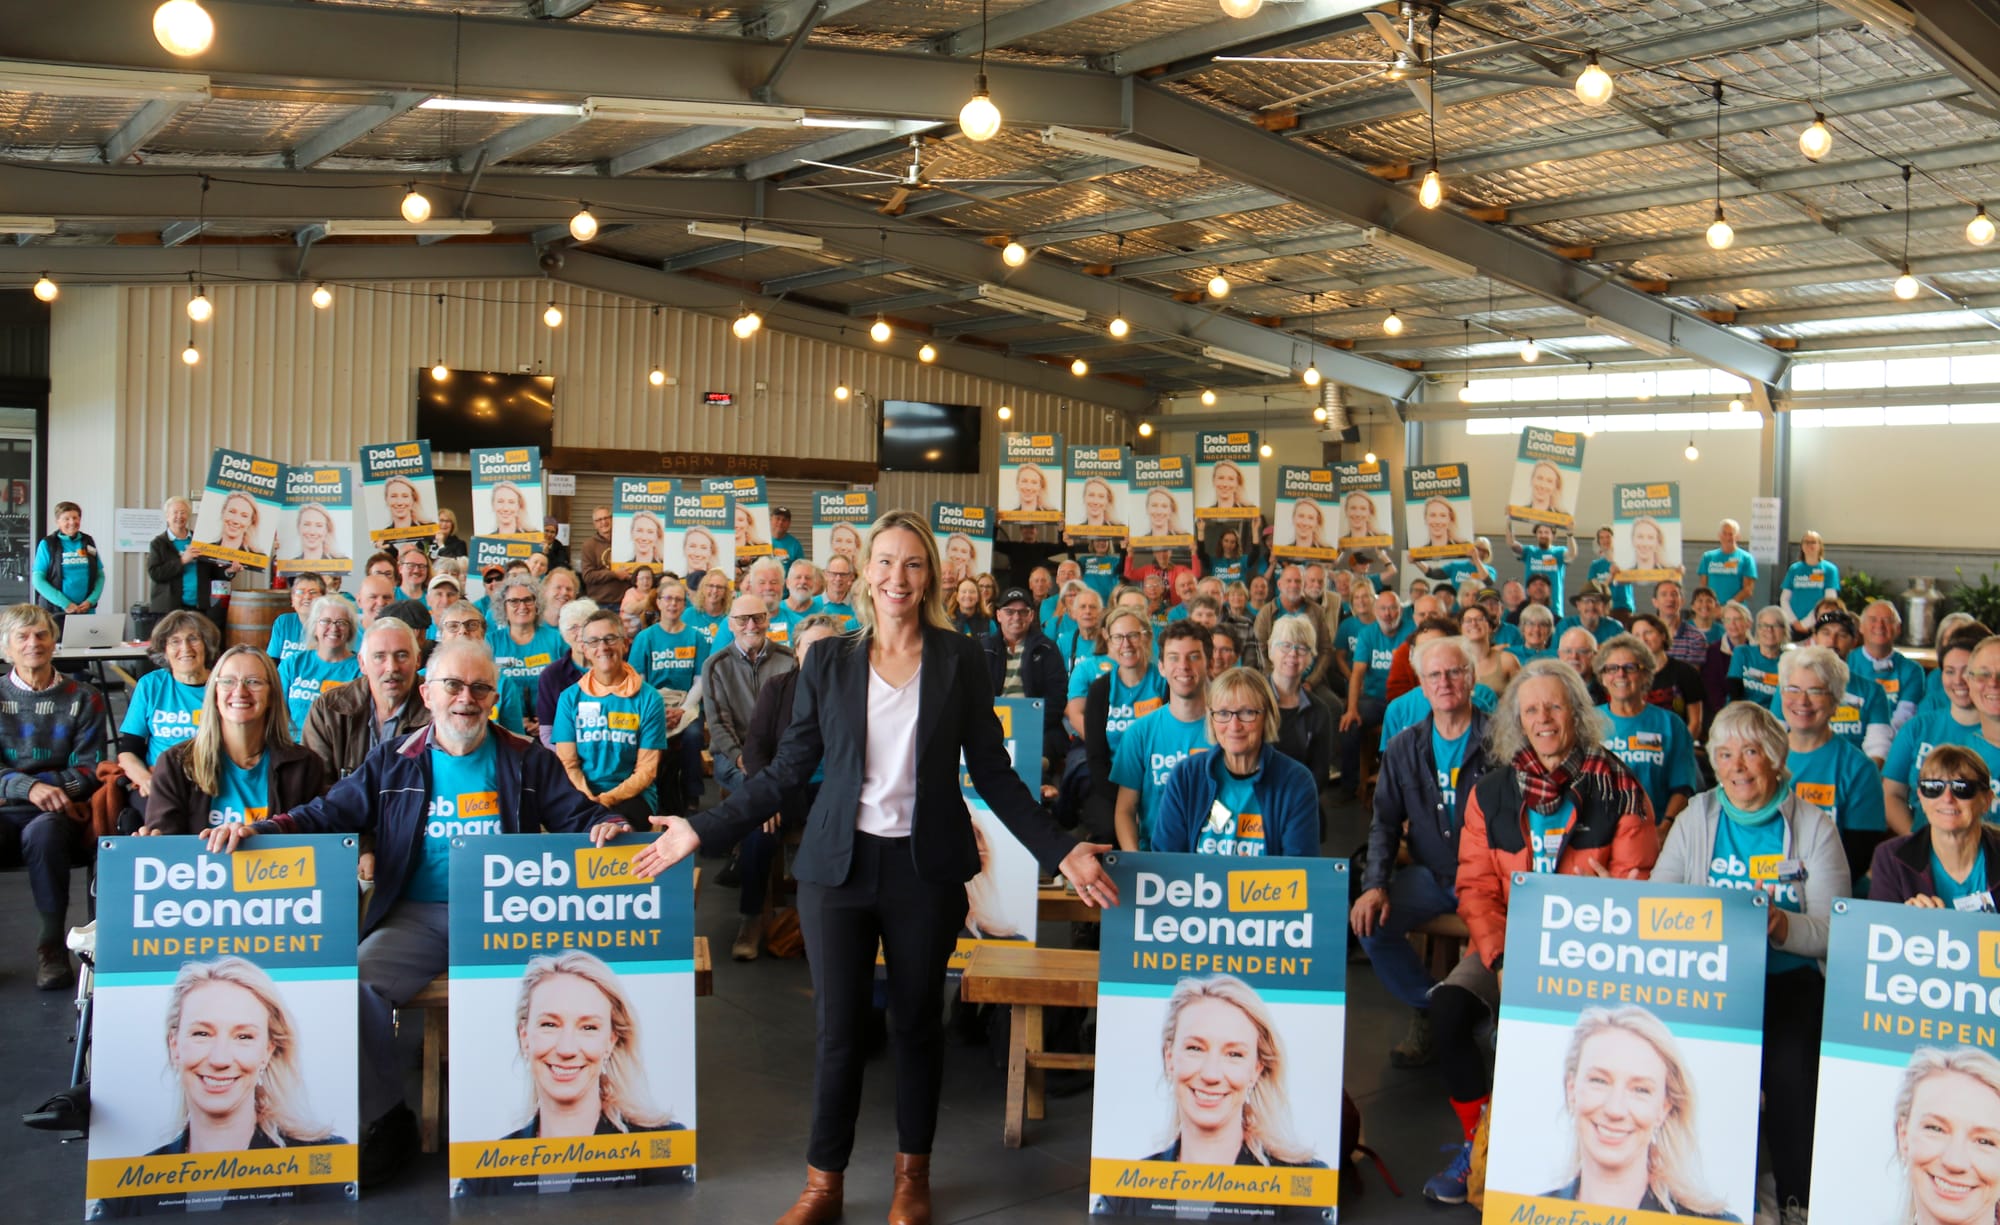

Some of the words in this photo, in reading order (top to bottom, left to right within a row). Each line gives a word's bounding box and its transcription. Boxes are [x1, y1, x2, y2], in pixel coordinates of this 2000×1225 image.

[1204, 434, 1227, 444] Deb
[1528, 429, 1552, 441] Deb
[1008, 437, 1030, 447] Deb
[1204, 443, 1251, 453] Leonard
[1527, 439, 1576, 457] Leonard
[369, 448, 395, 460] Deb
[1008, 446, 1054, 456] Leonard
[1075, 450, 1098, 459] Deb
[222, 455, 250, 470] Deb
[370, 455, 423, 470] Leonard
[479, 453, 505, 464] Deb
[1075, 460, 1121, 470] Leonard
[1136, 460, 1159, 470] Deb
[372, 467, 424, 477] INDEPENDENT
[479, 461, 531, 474] Leonard
[219, 466, 277, 489] Leonard
[287, 473, 314, 483] Deb
[1136, 469, 1183, 480] Leonard
[1286, 470, 1309, 481] Deb
[1340, 472, 1382, 483] eonard
[1412, 470, 1435, 480] Deb
[217, 480, 274, 497] INDEPENDENT
[286, 483, 342, 494] Leonard
[622, 482, 647, 493] Deb
[710, 480, 733, 491] Deb
[1285, 480, 1333, 492] Leonard
[1413, 477, 1462, 490] Leonard
[1621, 488, 1645, 499] Deb
[674, 496, 700, 507] Deb
[820, 496, 844, 505] Deb
[1622, 496, 1672, 509] Leonard
[674, 507, 726, 518] Leonard
[820, 504, 868, 515] Leonard
[940, 506, 962, 517] Deb
[939, 516, 985, 528] Leonard
[938, 525, 984, 535] INDEPENDENT
[479, 542, 506, 555] Deb
[283, 639, 306, 651] Deb
[652, 649, 674, 661] Deb
[1373, 649, 1392, 660] Deb
[289, 686, 322, 700] Leon
[153, 710, 191, 724] Deb
[576, 713, 607, 729] Deb
[1605, 736, 1626, 750] eb
[1800, 789, 1824, 801] Vote
[427, 795, 454, 817] eb
[464, 798, 490, 813] Vote
[209, 807, 242, 825] eb
[423, 820, 502, 838] onar
[245, 858, 289, 884] Vote
[294, 857, 306, 878] 1
[483, 853, 570, 887] Deb
[588, 855, 629, 880] Vote
[1712, 854, 1746, 876] eb
[1757, 863, 1778, 874] Vot
[133, 855, 227, 891] Deb
[1135, 872, 1222, 908] Deb
[1239, 880, 1281, 904] Vote
[1287, 880, 1298, 899] 1
[133, 890, 322, 928] Leonard
[483, 886, 660, 923] Leonard
[1542, 894, 1632, 936] Deb
[1650, 906, 1695, 932] Vote
[1701, 909, 1713, 930] 1
[1134, 909, 1312, 948] Leonard
[132, 935, 323, 956] INDEPENDENT
[483, 929, 662, 950] INDEPENDENT
[1867, 923, 1970, 971] Deb
[1133, 951, 1312, 975] INDEPENDENT
[1539, 931, 1728, 982] Leonard
[1536, 975, 1727, 1011] INDEPENDENT
[1863, 1011, 1996, 1048] INDEPEN
[476, 1140, 641, 1170] MoreForMonash
[117, 1155, 299, 1189] MoreForMonash
[1115, 1168, 1281, 1193] MoreForMonash
